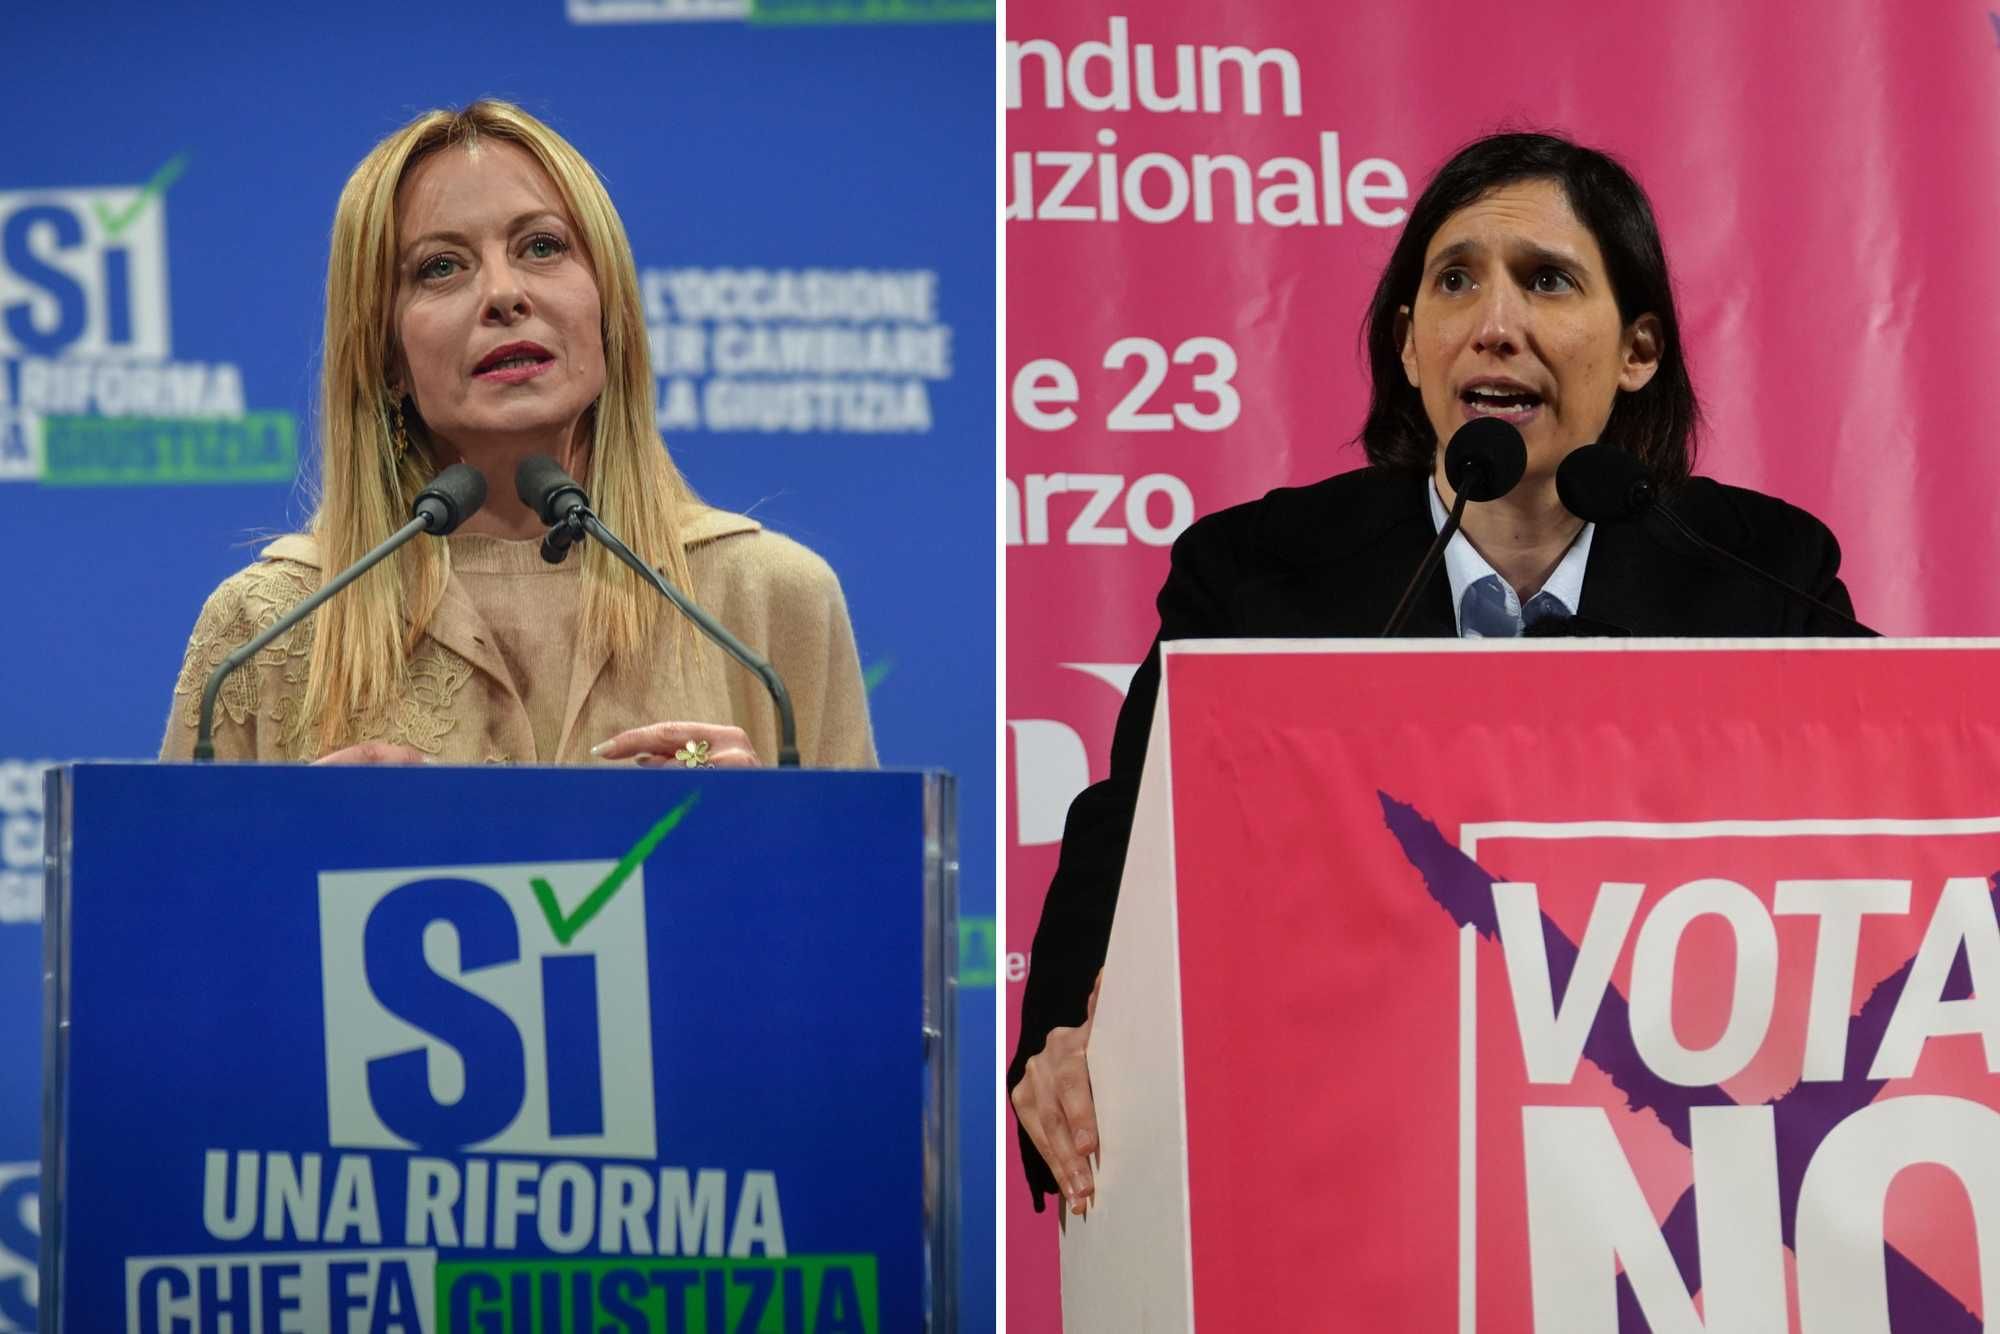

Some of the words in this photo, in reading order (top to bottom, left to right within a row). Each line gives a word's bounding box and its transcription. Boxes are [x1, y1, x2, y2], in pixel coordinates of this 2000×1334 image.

[1006, 16, 1302, 116] ndum
[713, 326, 951, 379] CAMBIARE
[1012, 358, 1080, 432] e
[1103, 336, 1241, 432] 23
[704, 378, 933, 431] GIUSTIZIA
[1491, 877, 2000, 1088] VOTA
[203, 1149, 382, 1244] UNA
[405, 1157, 788, 1259] RIFORMA
[1522, 1094, 2000, 1334] NO
[138, 1264, 302, 1334] CHE
[328, 1260, 419, 1334] FA
[447, 1265, 877, 1334] GIUSTIZIA
